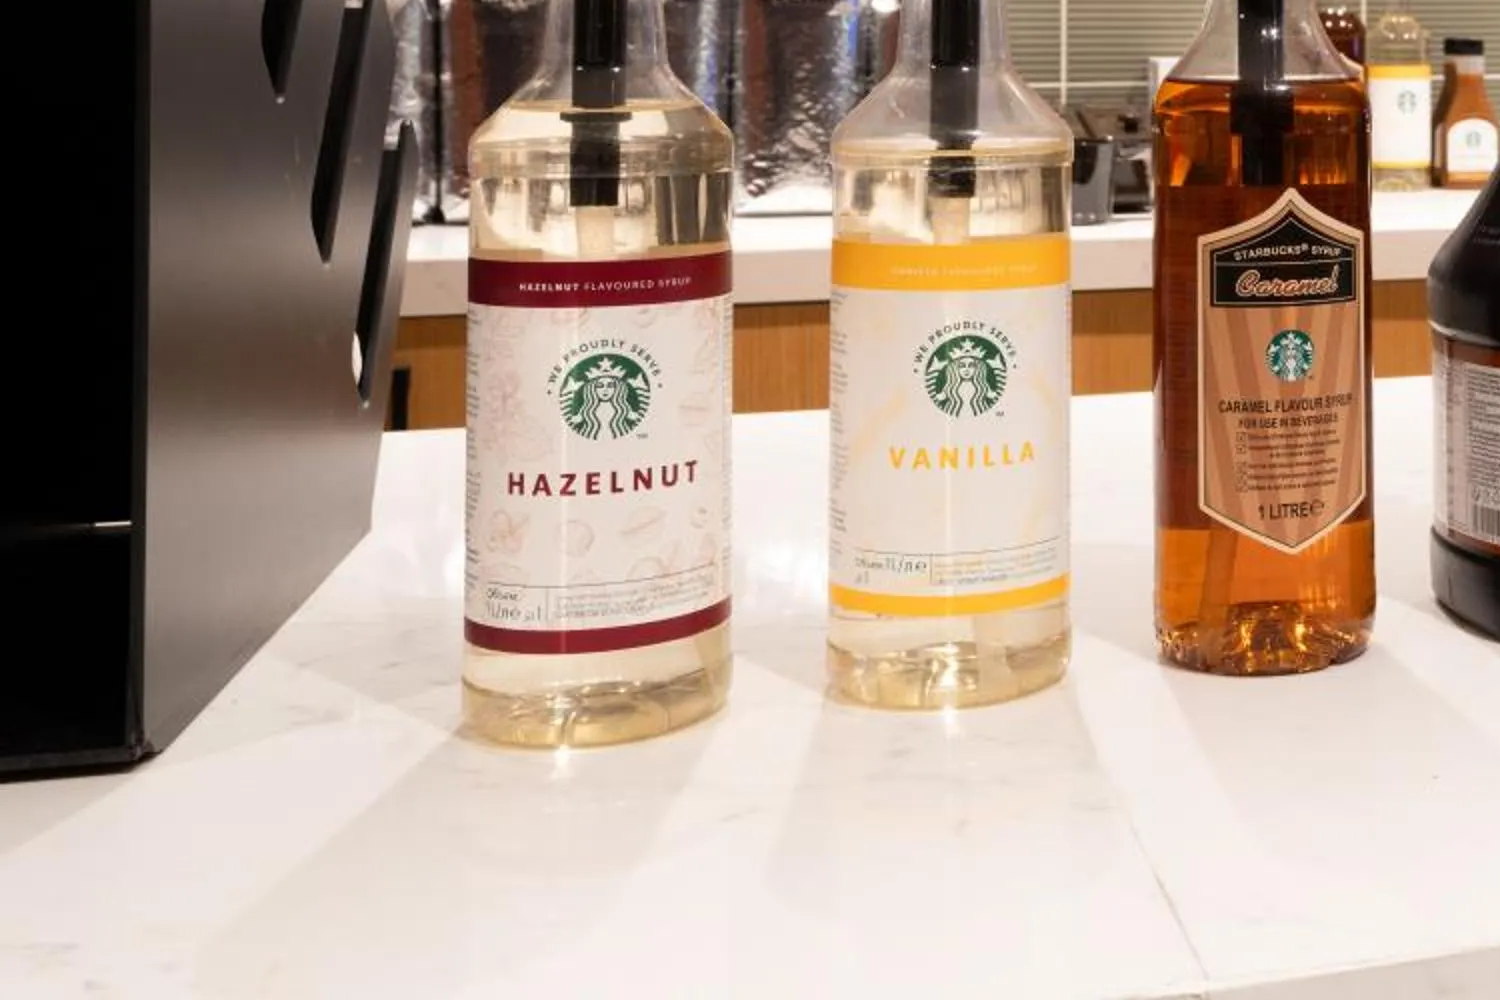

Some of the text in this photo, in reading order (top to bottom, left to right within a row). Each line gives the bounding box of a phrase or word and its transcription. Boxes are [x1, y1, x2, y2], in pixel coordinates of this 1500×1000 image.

[583, 278, 655, 292] FLAVOURED
[1235, 263, 1340, 297] Caramel
[1218, 399, 1272, 414] CARAMEL
[1274, 397, 1323, 412] FLAVOUR
[889, 441, 1035, 470] VANILLA
[507, 460, 698, 496] HAZELNUT
